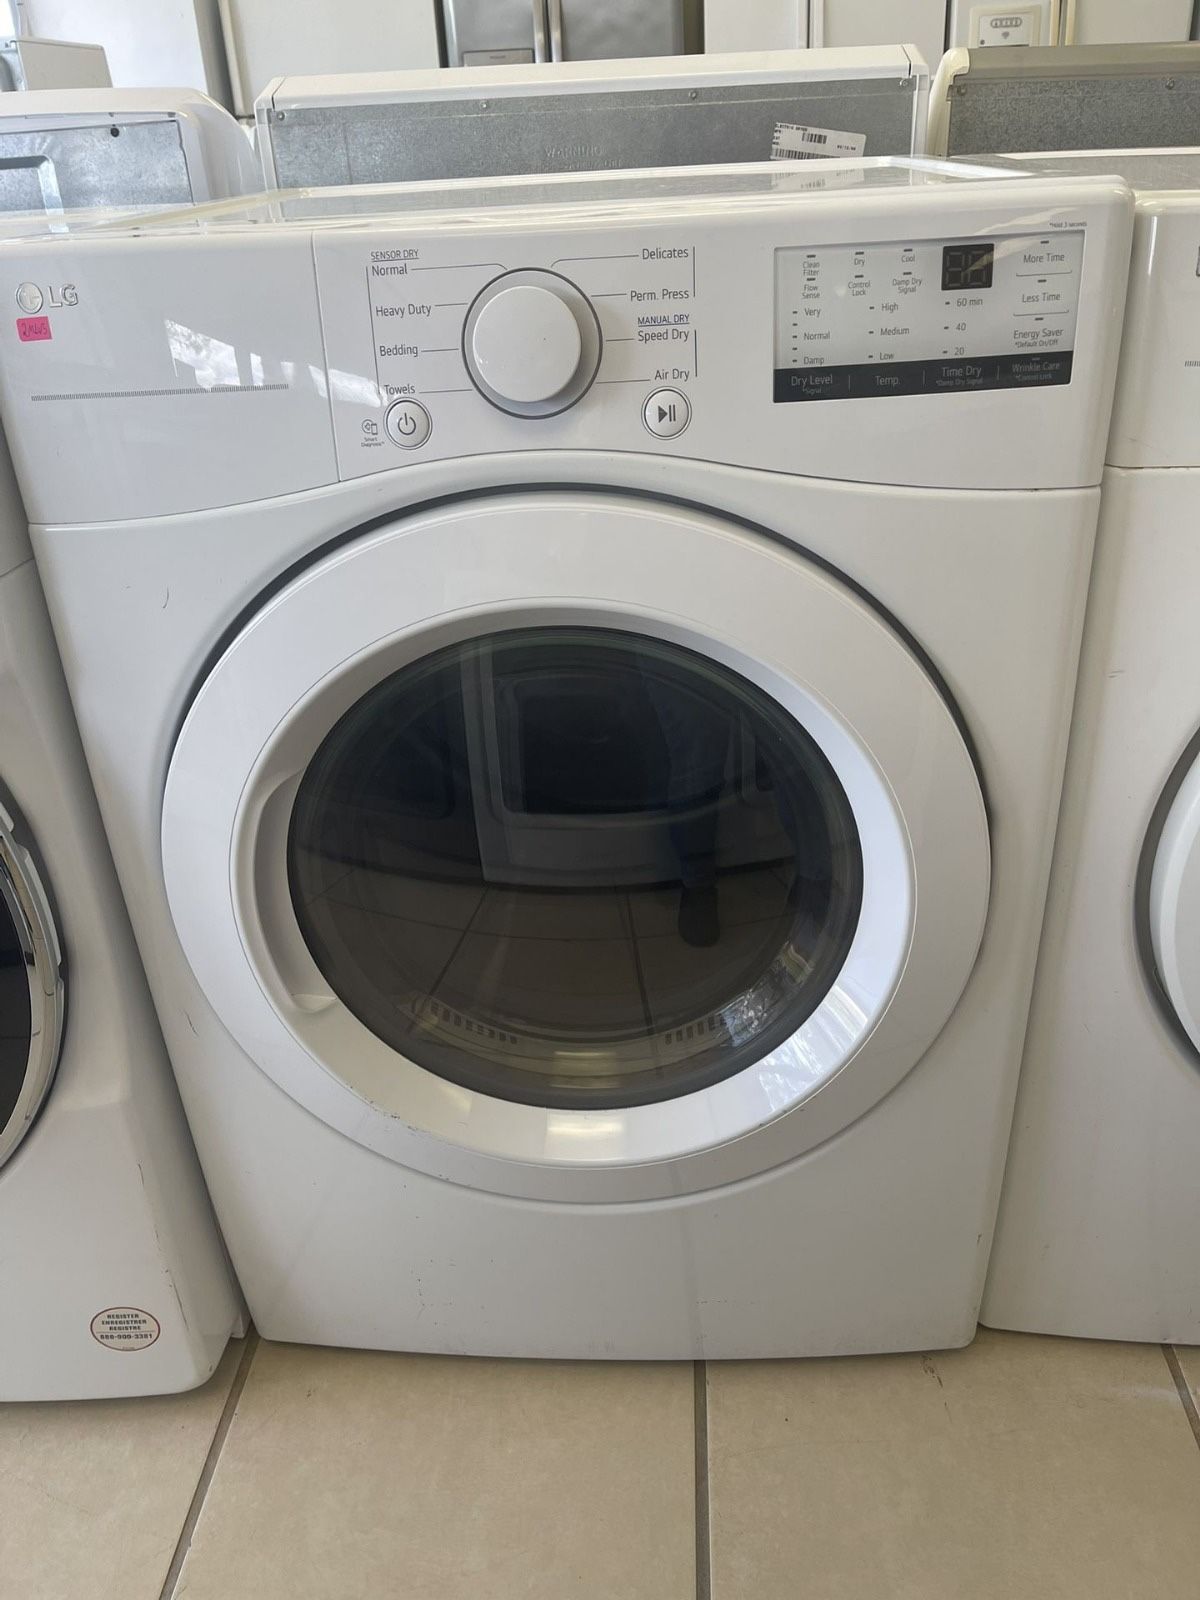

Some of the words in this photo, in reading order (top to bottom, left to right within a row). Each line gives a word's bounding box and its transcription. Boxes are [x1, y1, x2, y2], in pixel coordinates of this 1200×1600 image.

[371, 250, 401, 260] SENSOR
[404, 249, 419, 258] DRY
[642, 248, 688, 260] Delicates
[902, 254, 915, 263] Cool
[1023, 254, 1044, 263] More
[1046, 252, 1065, 262] Time
[854, 258, 865, 267] Dry
[372, 263, 407, 276] Normal
[848, 281, 870, 289] Control
[892, 278, 910, 286] Damp
[912, 277, 922, 286] Dry
[630, 290, 659, 302] Perm.
[662, 288, 689, 300] Press
[898, 286, 916, 294] Signal
[48, 284, 79, 308] LG
[1022, 294, 1040, 303] Less
[1042, 292, 1060, 301] Time
[881, 303, 898, 313] High
[956, 298, 967, 307] 60
[376, 305, 405, 318] Heavy
[408, 304, 432, 317] Duty
[804, 308, 821, 317] Very
[638, 316, 670, 325] MANUAL
[674, 314, 689, 323] DRY
[880, 327, 910, 336] Medium
[956, 323, 966, 331] 40
[638, 329, 668, 344] Speed
[672, 328, 689, 342] Dry
[804, 331, 830, 340] Normal
[1013, 330, 1039, 340] Energy
[1042, 328, 1064, 337] Saver
[380, 345, 418, 357] Bedding
[880, 352, 894, 360] Low
[954, 347, 964, 356] 20
[804, 357, 824, 365] Damp
[1012, 362, 1040, 372] Wrinkle
[1043, 361, 1060, 370] Care
[654, 369, 669, 380] Air
[672, 368, 690, 382] Dry
[942, 367, 964, 377] Time
[966, 366, 982, 378] Dry
[791, 376, 807, 386] Dry
[810, 374, 833, 385] Level
[875, 375, 900, 386] Temp.
[384, 384, 416, 395] Towels
